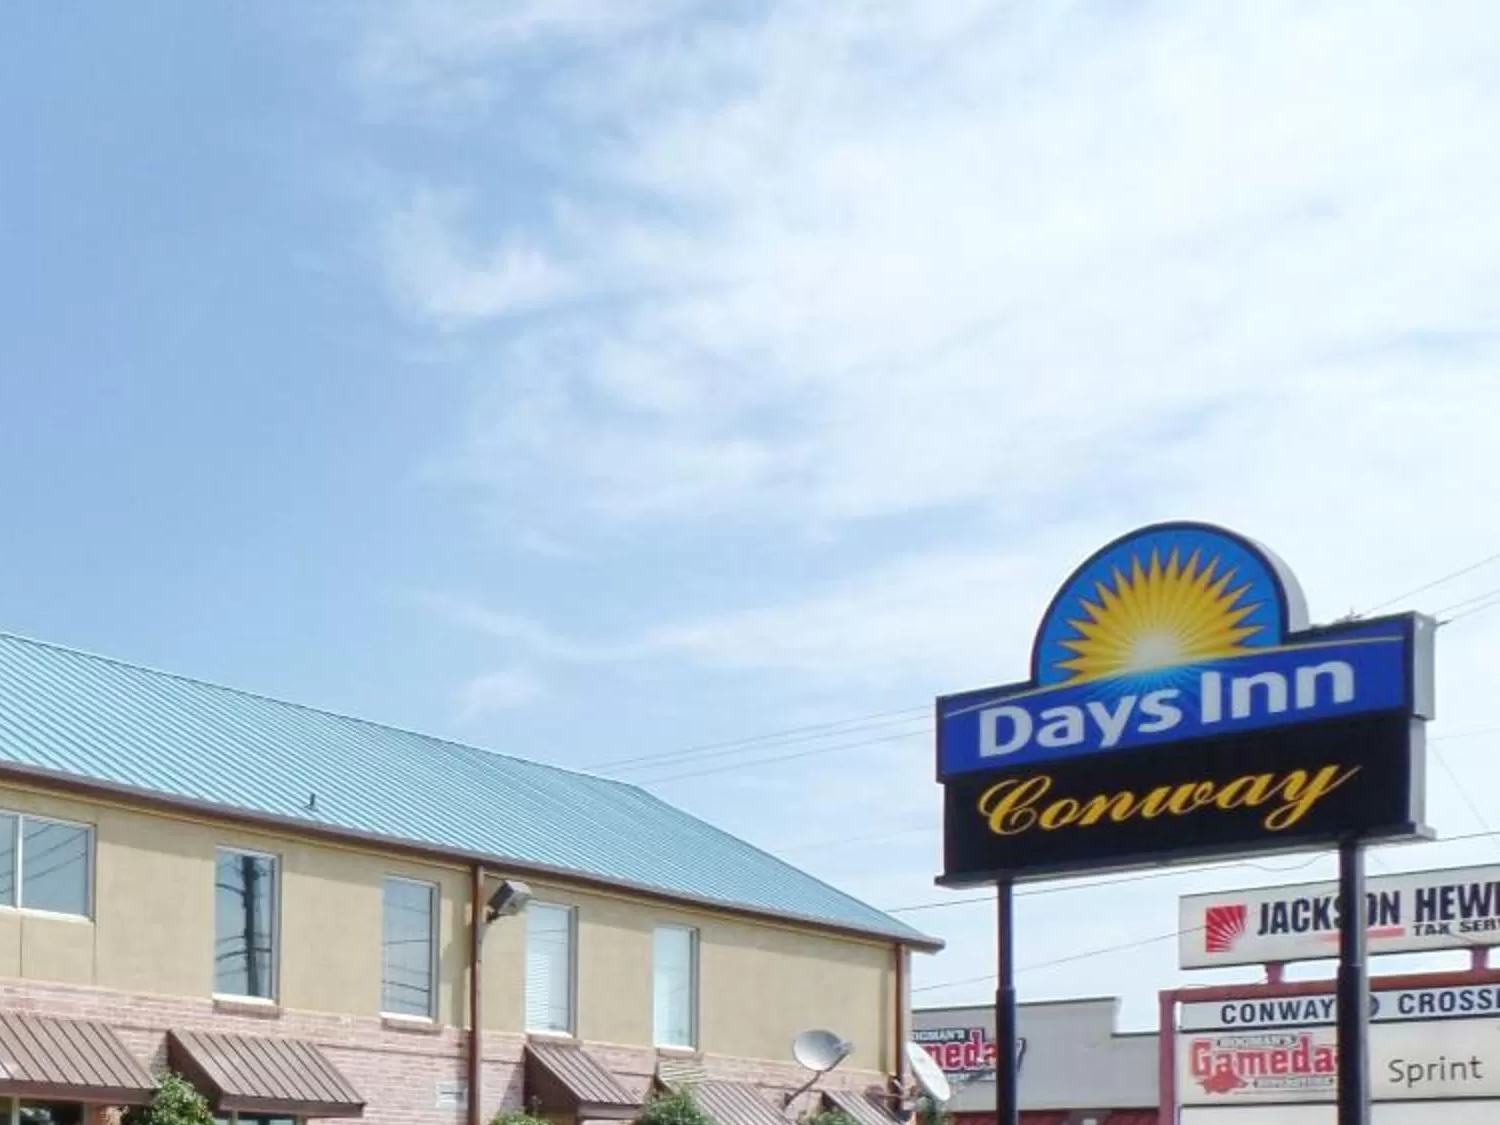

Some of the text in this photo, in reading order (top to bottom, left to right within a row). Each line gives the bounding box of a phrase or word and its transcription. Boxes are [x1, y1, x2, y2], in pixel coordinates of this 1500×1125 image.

[978, 660, 1355, 758] Days Inn
[976, 763, 1363, 835] Conway
[1413, 922, 1449, 937] TAX
[1220, 998, 1337, 1025] CONWAY
[1189, 1034, 1338, 1079] Gameda
[1387, 1055, 1485, 1089] Sprint
